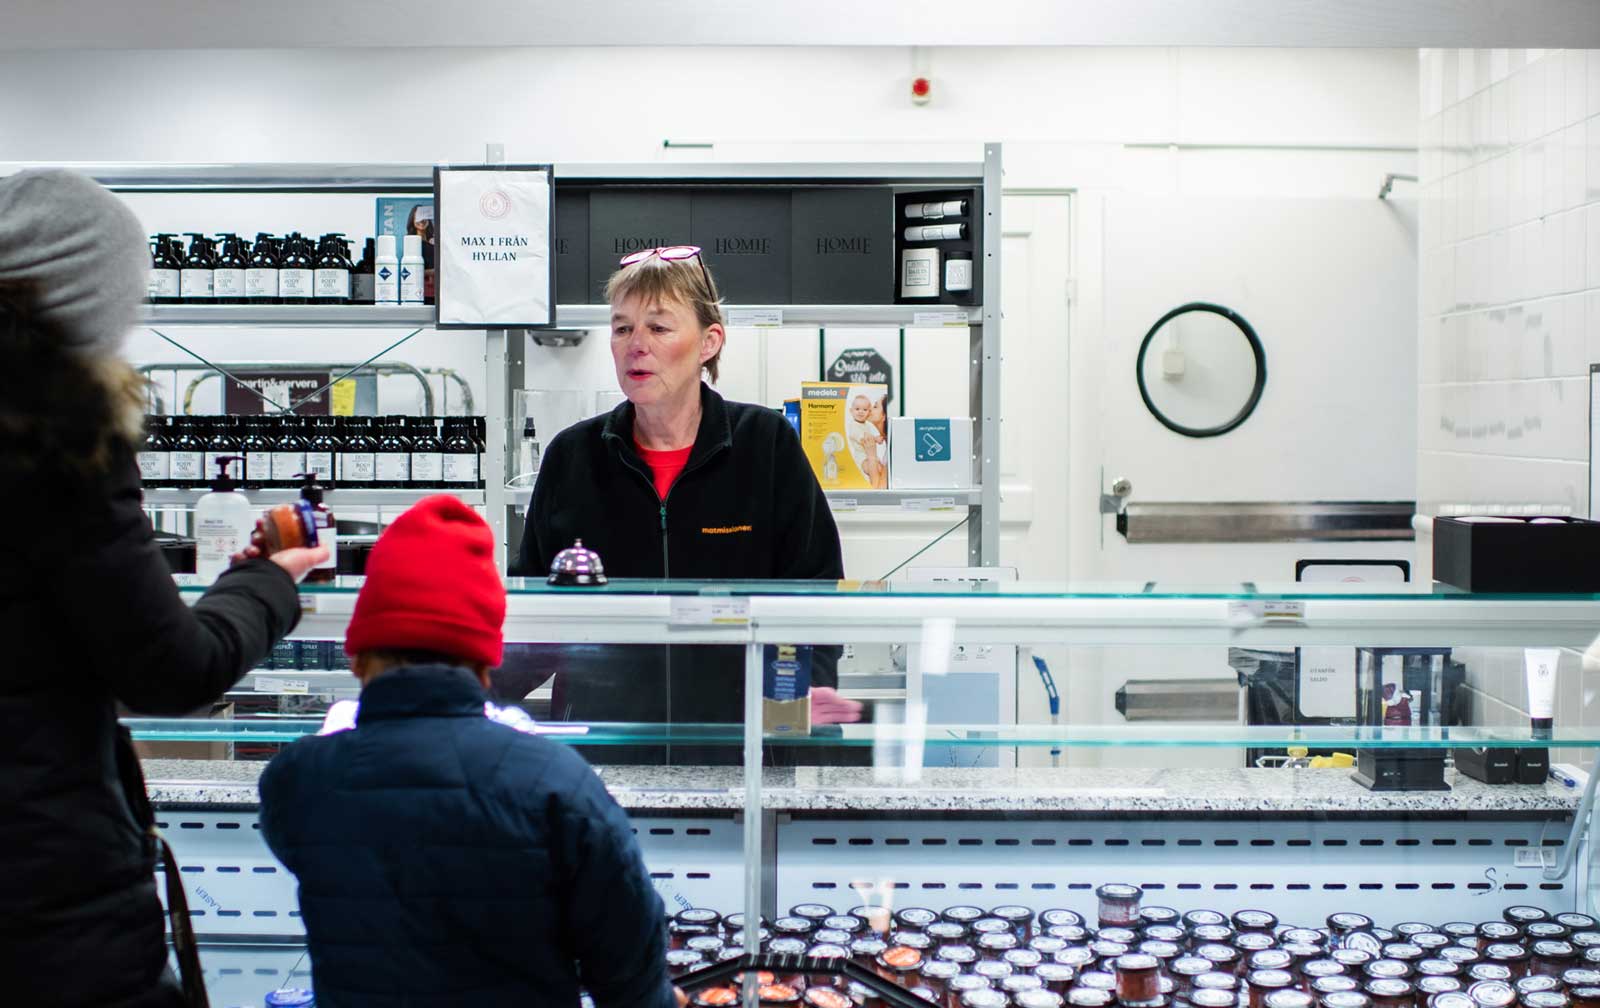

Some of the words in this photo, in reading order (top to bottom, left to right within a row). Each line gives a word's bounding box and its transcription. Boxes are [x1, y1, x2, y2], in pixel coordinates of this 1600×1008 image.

[461, 236, 486, 246] MAX
[489, 236, 495, 246] 1
[498, 234, 528, 246] FRÅN
[714, 238, 770, 254] HOMIE
[815, 238, 872, 254] HOMIE
[472, 251, 517, 261] HYLLAN
[807, 389, 838, 397] medela
[807, 402, 835, 410] Harmony
